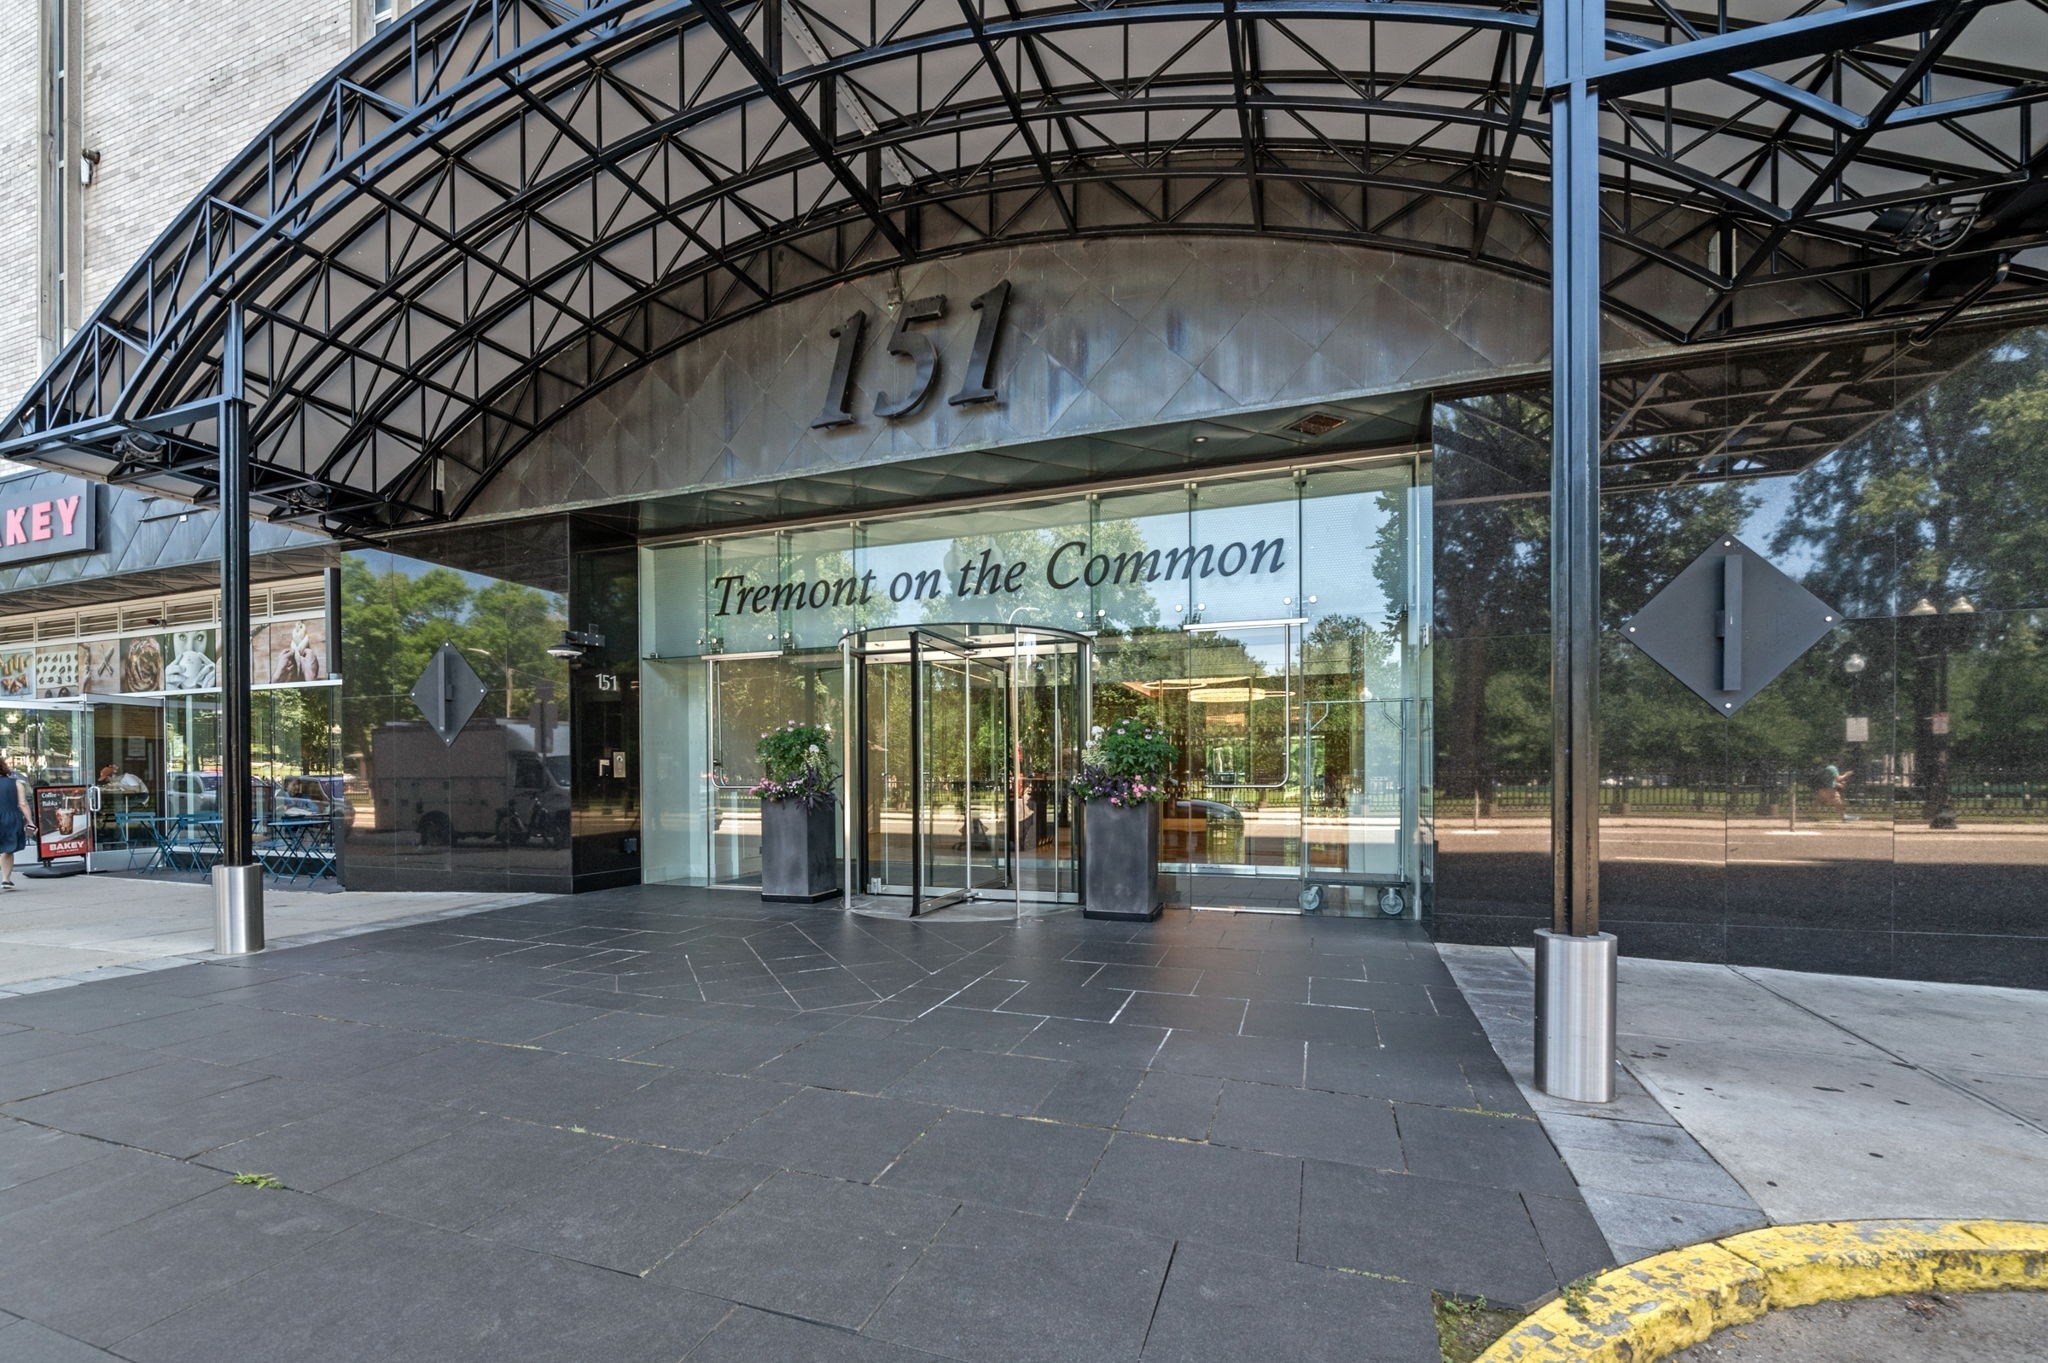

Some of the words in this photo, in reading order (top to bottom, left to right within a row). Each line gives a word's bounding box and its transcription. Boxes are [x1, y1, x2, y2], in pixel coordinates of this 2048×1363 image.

[811, 279, 1012, 430] 151
[0, 495, 80, 547] KEY
[714, 569, 877, 617] Tremont
[889, 568, 942, 602] on
[957, 548, 1027, 597] the
[1046, 537, 1285, 590] Common
[595, 673, 618, 691] 151
[49, 841, 84, 850] BAKEY
